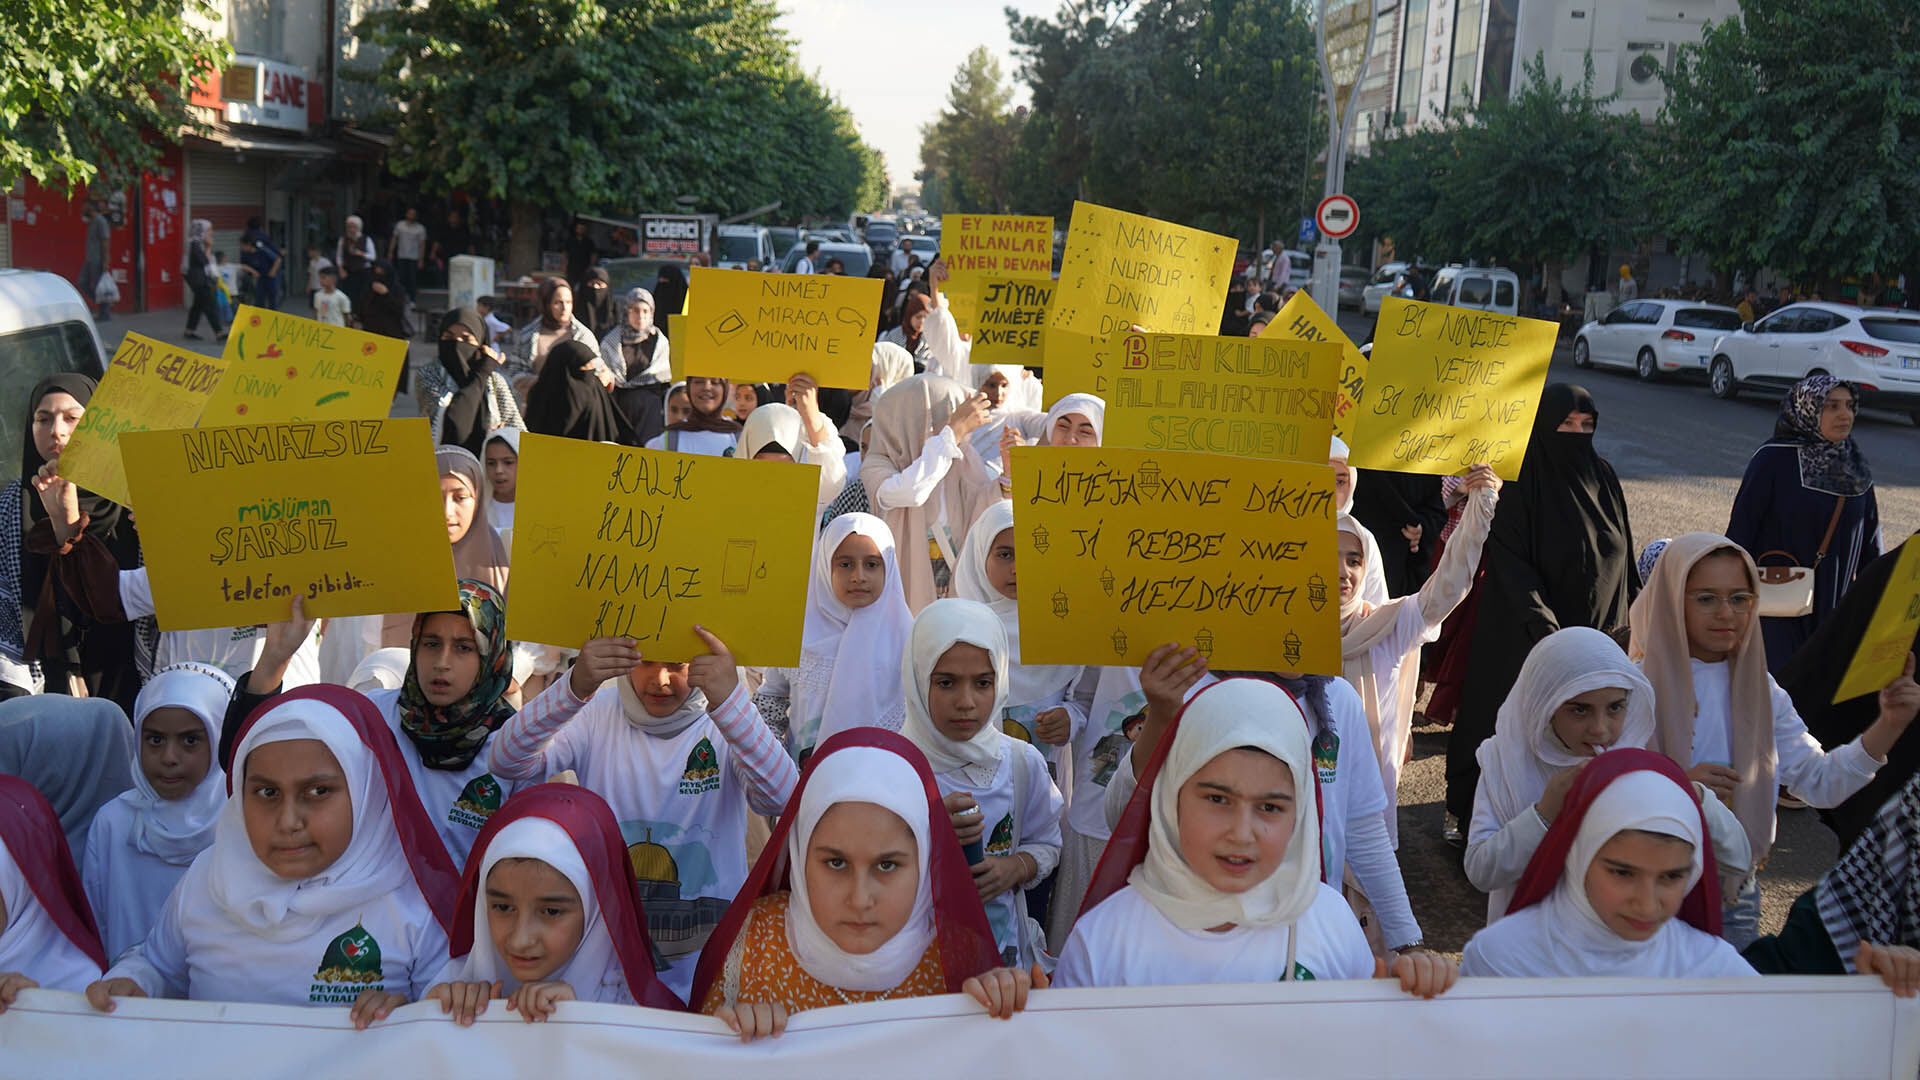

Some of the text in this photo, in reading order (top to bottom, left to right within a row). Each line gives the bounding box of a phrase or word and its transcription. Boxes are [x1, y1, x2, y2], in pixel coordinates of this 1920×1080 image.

[961, 217, 1048, 234] EY NAMAZ
[1115, 221, 1188, 259] NAMAZ
[960, 234, 1046, 254] KILANLAR
[946, 254, 1051, 273] AYNEN DEVAM
[1110, 257, 1183, 289] NURDUR
[762, 279, 832, 299] NIMÊJ
[984, 280, 1052, 306] JÎYAN
[267, 315, 336, 350] NAMAZ
[827, 338, 841, 354] E
[976, 328, 1040, 349] XWEŞE
[114, 337, 153, 375] ZOR
[1123, 334, 1202, 371] BEN
[1214, 341, 1311, 378] KILDIM
[311, 359, 386, 389] NURDUR
[1115, 377, 1218, 411] ALLAH
[1480, 399, 1526, 425] XWE
[183, 420, 389, 474] NAMAZSIZ
[608, 452, 696, 500] KALK
[1160, 478, 1231, 506] XWE
[238, 498, 332, 522] müslüman
[1127, 529, 1226, 564] REBBE
[1239, 538, 1308, 562] XWE
[221, 573, 292, 602] telefon
[576, 553, 702, 602] NAMAZ
